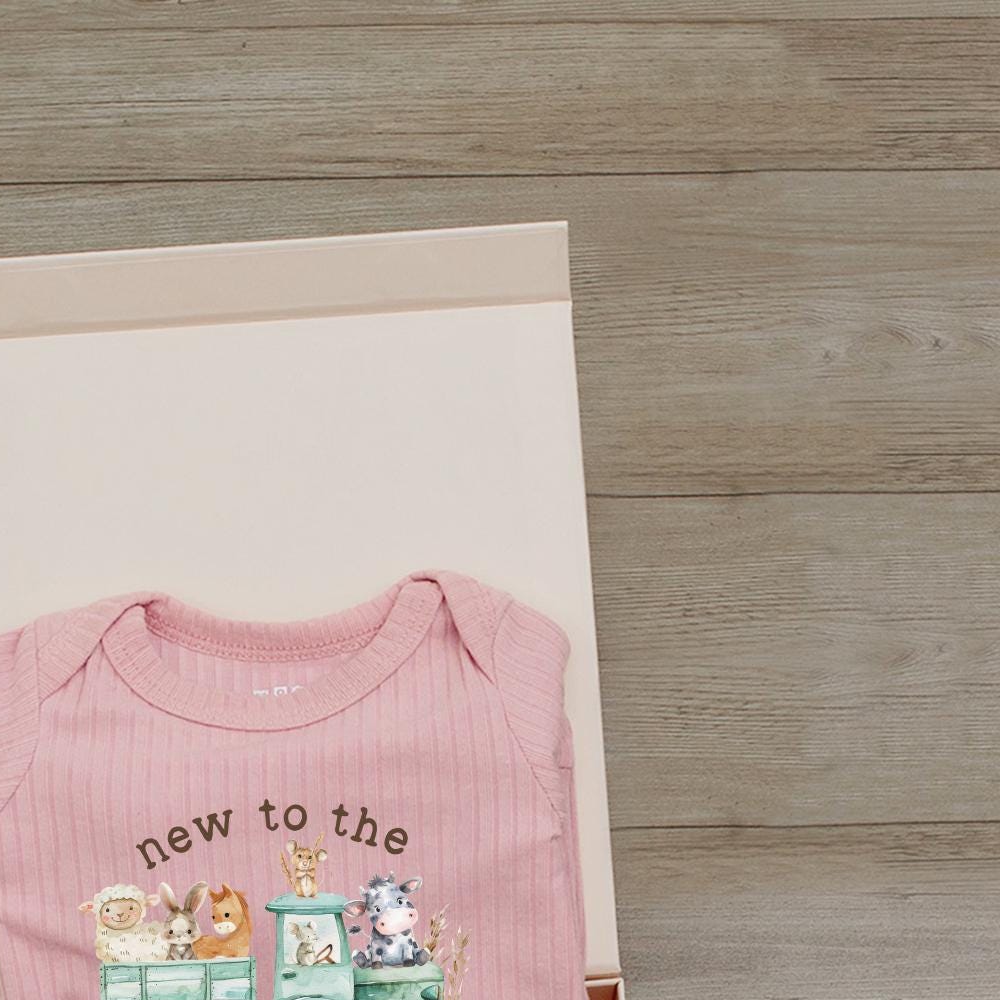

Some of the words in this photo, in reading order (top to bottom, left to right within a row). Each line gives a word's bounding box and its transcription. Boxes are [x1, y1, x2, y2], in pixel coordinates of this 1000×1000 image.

[135, 809, 233, 870] new
[258, 798, 308, 833] to
[331, 803, 409, 855] the
